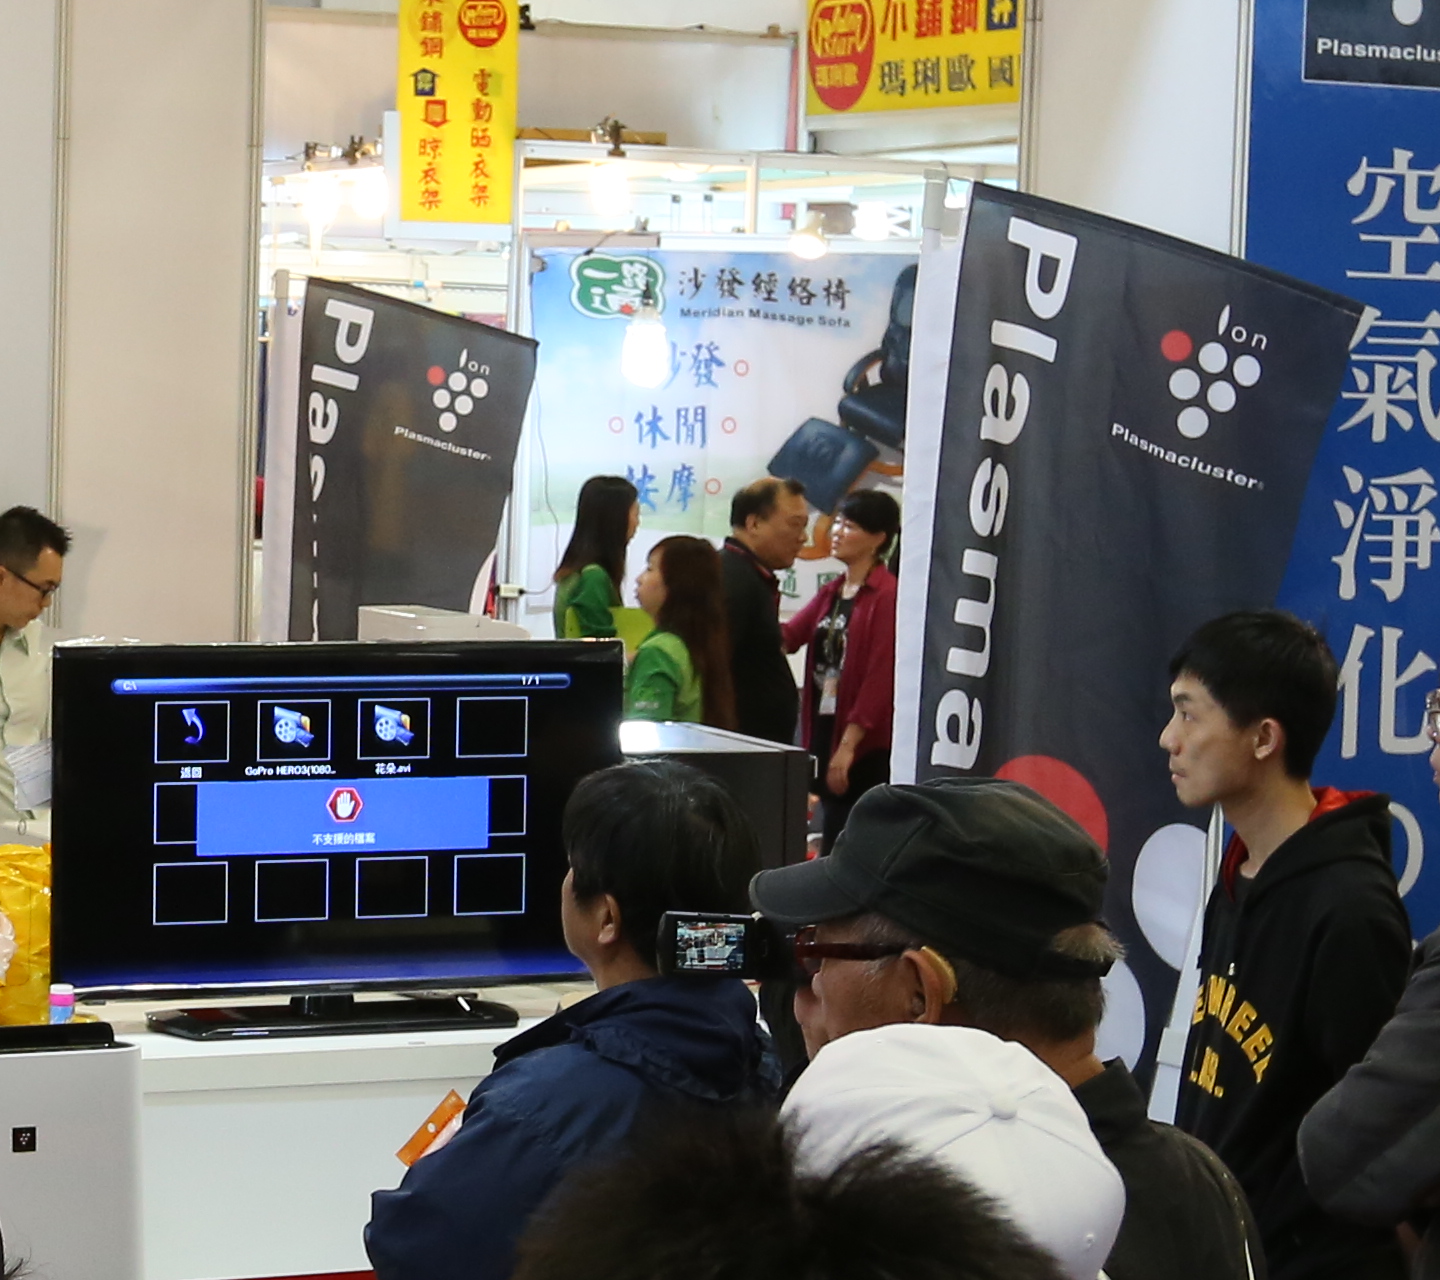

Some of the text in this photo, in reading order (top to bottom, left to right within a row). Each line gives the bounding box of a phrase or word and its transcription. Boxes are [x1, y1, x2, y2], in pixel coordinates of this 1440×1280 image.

[678, 267, 852, 312] 沙發經絡椅
[680, 307, 852, 328] Meridian Massage Sofa
[393, 425, 490, 462] Plasmacluster
[1110, 422, 1258, 491] Plasmacluster
[931, 216, 1079, 773] Plasma
[521, 675, 541, 686] 1/1
[244, 766, 273, 776] GoPro
[312, 831, 377, 846] 不支援的檔案
